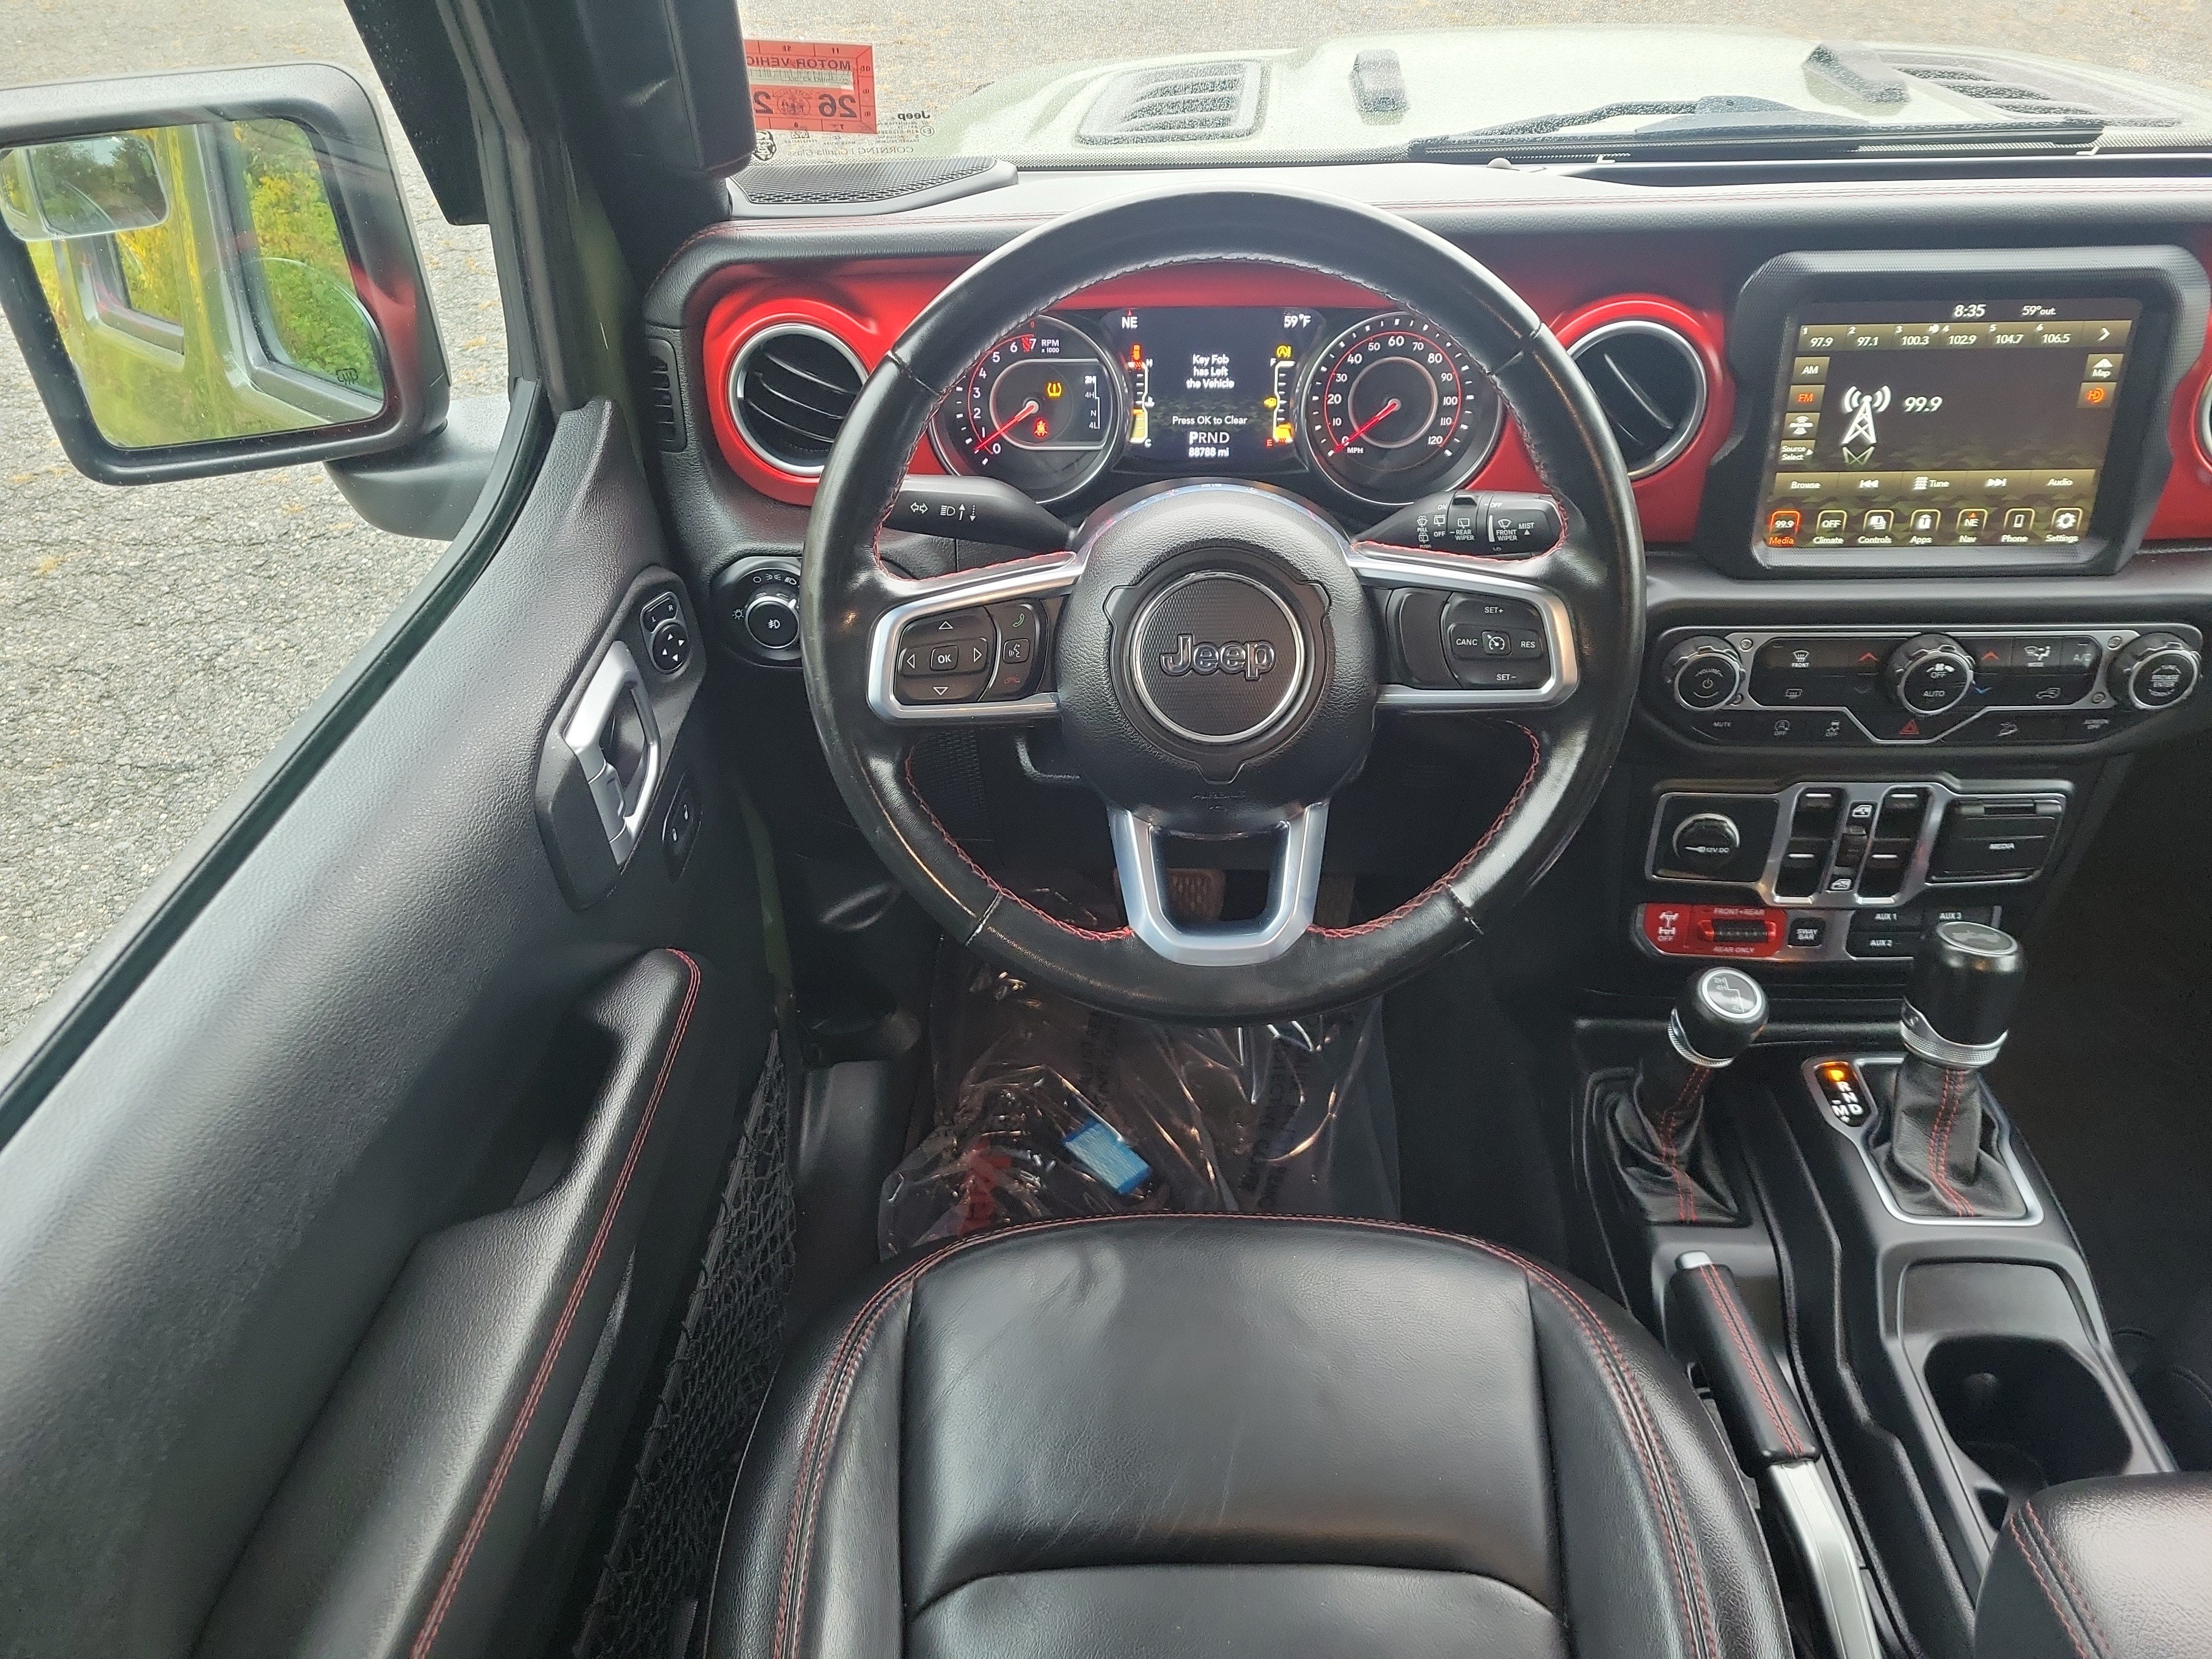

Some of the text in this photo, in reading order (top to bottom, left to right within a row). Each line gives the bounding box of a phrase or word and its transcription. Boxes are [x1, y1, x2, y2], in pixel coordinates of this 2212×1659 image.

[1954, 304, 1986, 318] 8:35
[1121, 317, 1138, 329] NE
[1284, 314, 1312, 328] 59°F
[1895, 325, 1903, 334] 3
[2036, 323, 2044, 331] 6
[1029, 338, 1037, 349] 7
[1388, 336, 1404, 347] 60
[1810, 337, 1833, 347] 97.9
[1857, 336, 1878, 346] 97.1
[1901, 336, 1929, 346] 100.3
[1949, 335, 1977, 345] 102.9
[1995, 334, 2024, 344] 104.7
[2042, 334, 2070, 343] 106.5
[1010, 342, 1018, 353] 6
[1368, 342, 1380, 352] 50
[1412, 341, 1424, 351] 70
[992, 351, 1001, 363] 5
[1193, 354, 1229, 366] Key Fob
[1270, 358, 1277, 366] F
[1347, 353, 1362, 364] 40
[1427, 353, 1443, 364] 80
[1146, 359, 1153, 368] H
[979, 368, 987, 379] 4
[1193, 366, 1229, 376] has Left
[1802, 365, 1819, 375] AM
[2092, 369, 2111, 378] Map
[1336, 373, 1347, 382] 30
[1441, 373, 1453, 382] 90
[1186, 378, 1235, 388] the Vehicle
[973, 387, 981, 398] 3
[1798, 393, 1813, 402] FM
[1327, 394, 1342, 405] 20
[1443, 396, 1458, 406] 100
[1904, 396, 1943, 411] 99.9
[973, 408, 981, 419] 2
[1172, 415, 1248, 425] Press OK to Clear
[1332, 417, 1342, 426] 10
[1440, 417, 1452, 426] 110
[981, 426, 985, 438] 1
[1189, 431, 1230, 444] PRND
[1428, 436, 1443, 445] 120
[992, 442, 1001, 454] 0
[1144, 439, 1152, 448] C
[1188, 447, 1229, 458] 88788 mi
[2046, 478, 2073, 486] Audio
[1775, 520, 1795, 528] 99.9
[1964, 518, 1979, 527] NE
[1769, 537, 1795, 545] Media
[1813, 536, 1844, 544] Climate
[1858, 535, 1892, 544] Controls
[1910, 536, 1932, 544] Apps
[2001, 534, 2028, 543] Phone
[2045, 534, 2079, 544] Settings
[938, 654, 952, 664] OK
[1160, 634, 1276, 681] Jeep
[1939, 912, 1955, 920] AUX
[1836, 1081, 1852, 1092] R
[1842, 1092, 1858, 1103] N
[1831, 1103, 1863, 1117] M D
